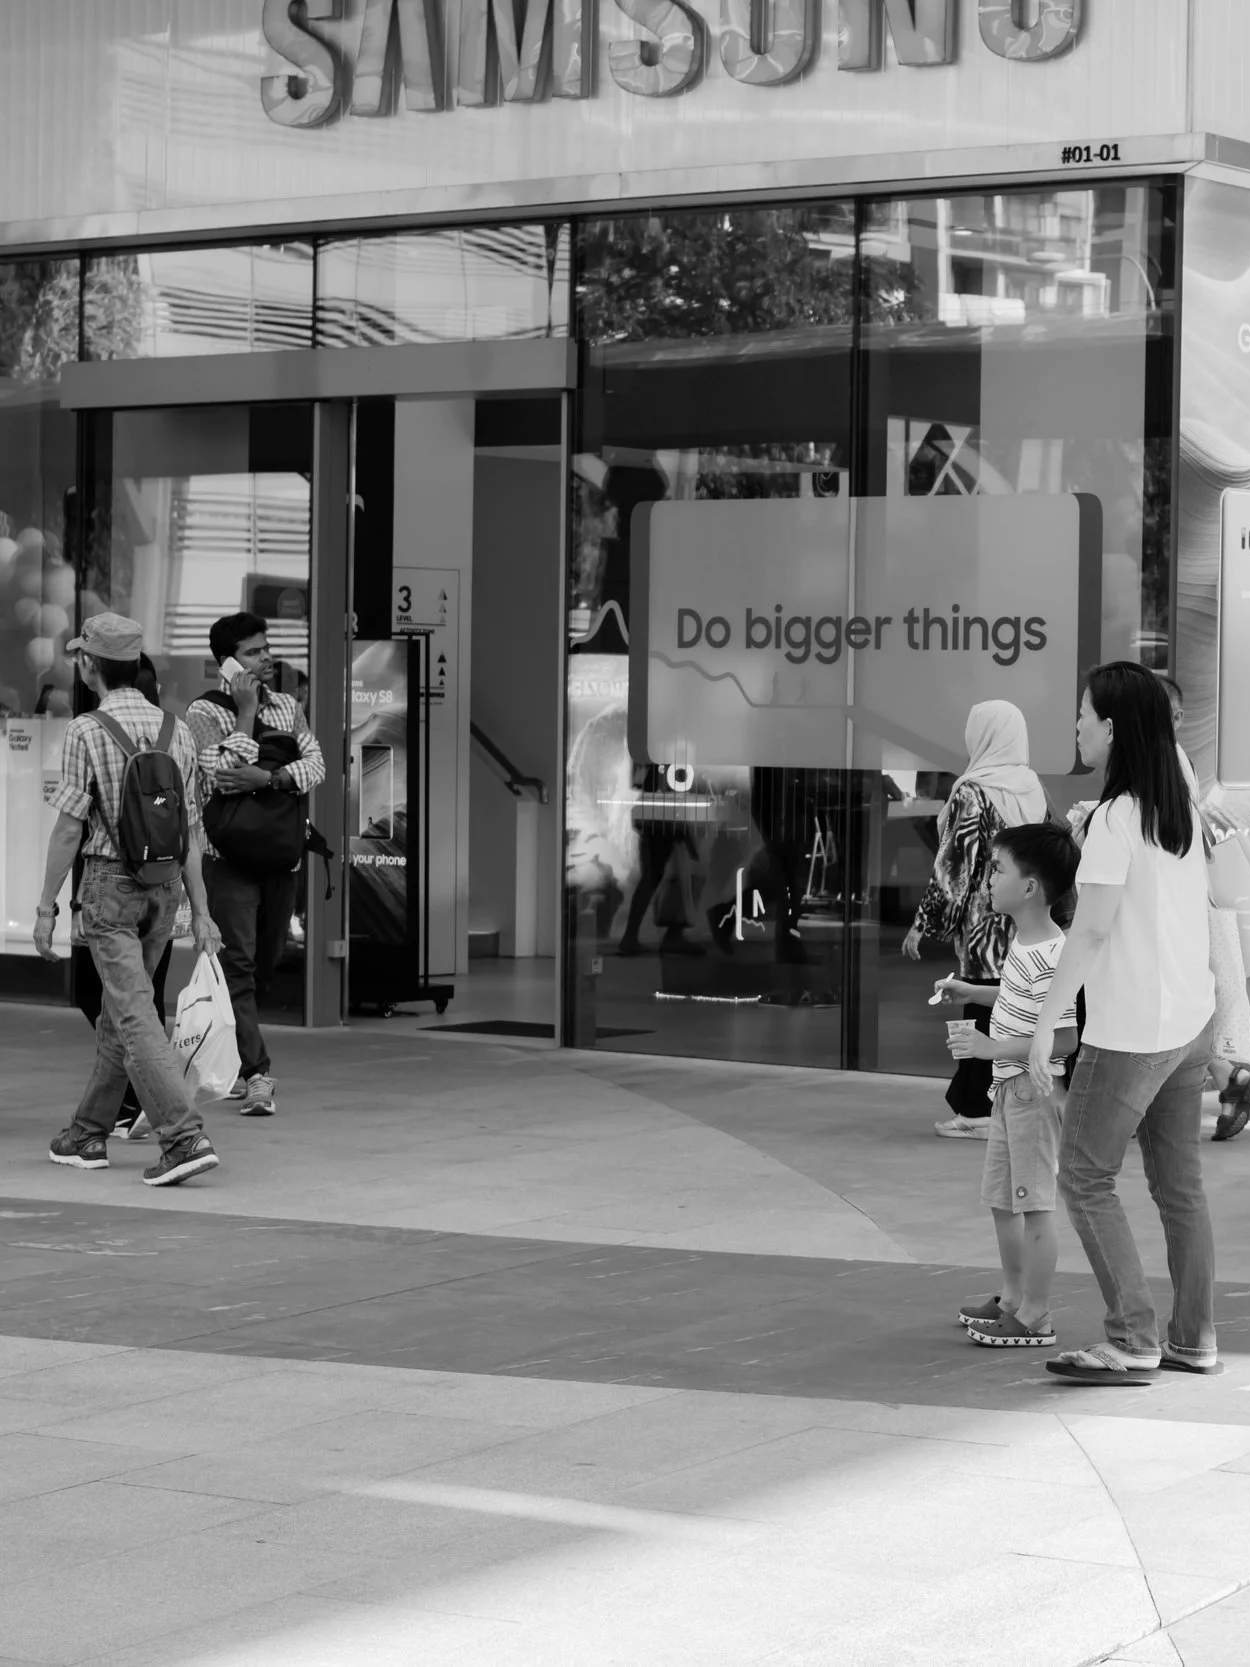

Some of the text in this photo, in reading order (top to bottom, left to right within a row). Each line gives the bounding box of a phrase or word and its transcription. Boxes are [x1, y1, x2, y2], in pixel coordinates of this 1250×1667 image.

[1061, 143, 1121, 164] #01-01
[398, 585, 412, 613] 3
[677, 604, 1047, 666] Do bigger things
[352, 690, 393, 706] laxy S8
[353, 854, 374, 867] your
[375, 854, 407, 867] phone
